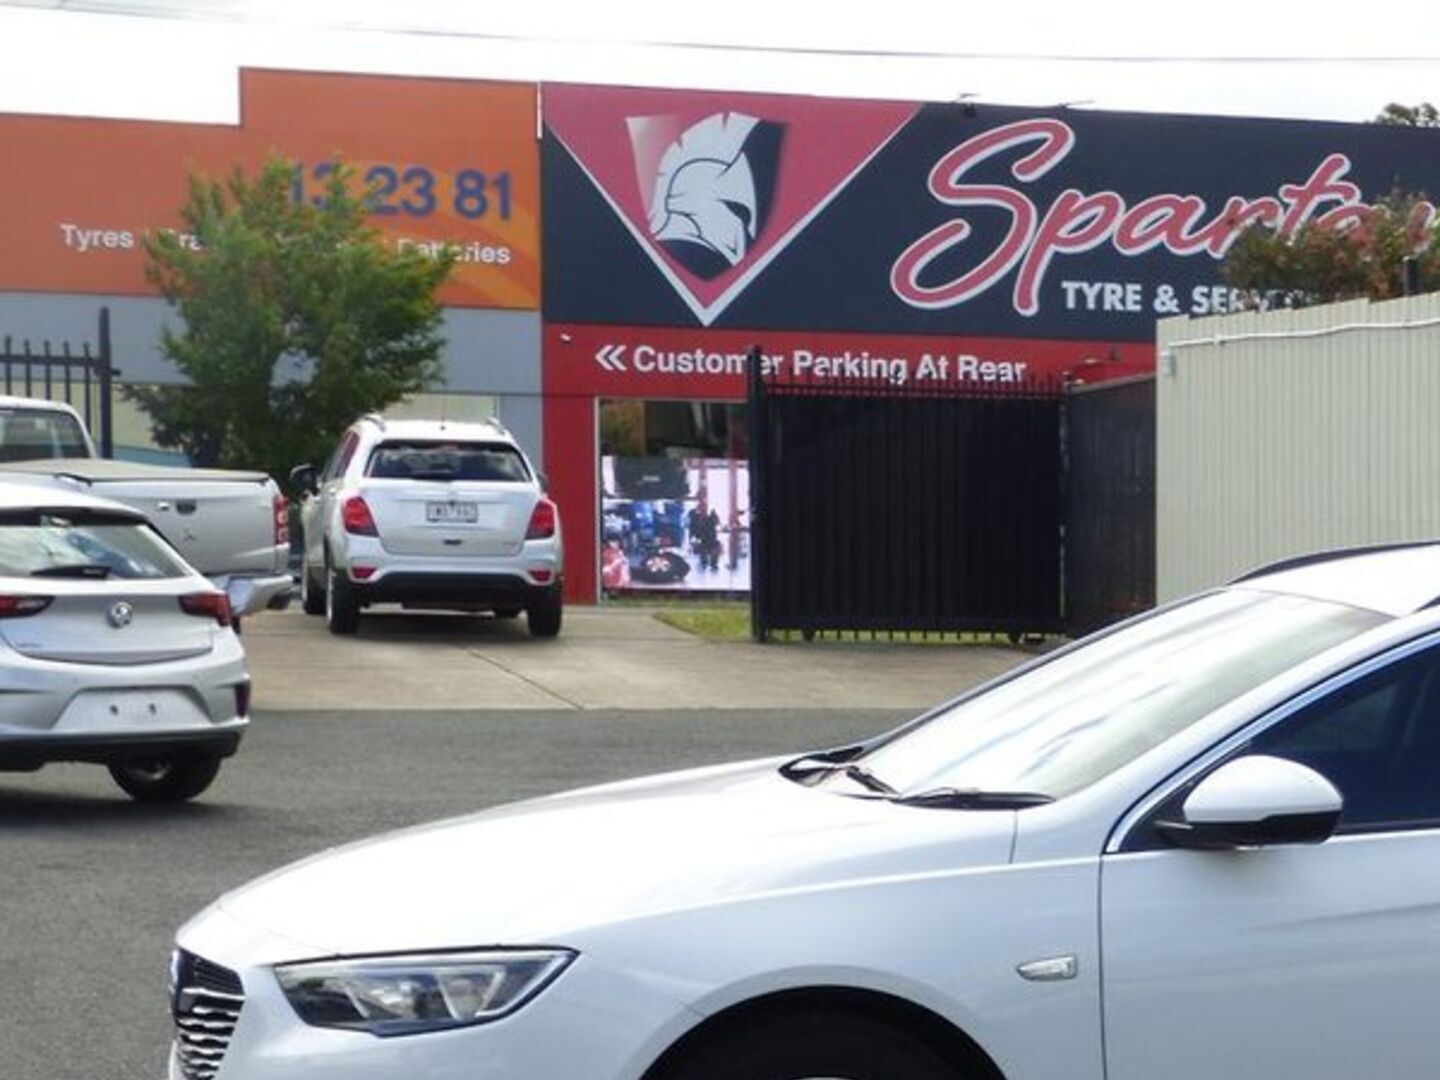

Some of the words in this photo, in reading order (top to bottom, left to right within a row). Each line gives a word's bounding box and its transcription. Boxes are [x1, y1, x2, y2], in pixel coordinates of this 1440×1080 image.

[364, 165, 438, 217] 23
[454, 169, 512, 220] 81
[60, 223, 135, 252] Tyres
[1061, 280, 1142, 312] TYRE
[1153, 284, 1180, 314] &
[633, 345, 784, 376] Customer
[793, 349, 908, 384] Parking
[916, 354, 949, 380] At
[957, 355, 1027, 382] Rear
